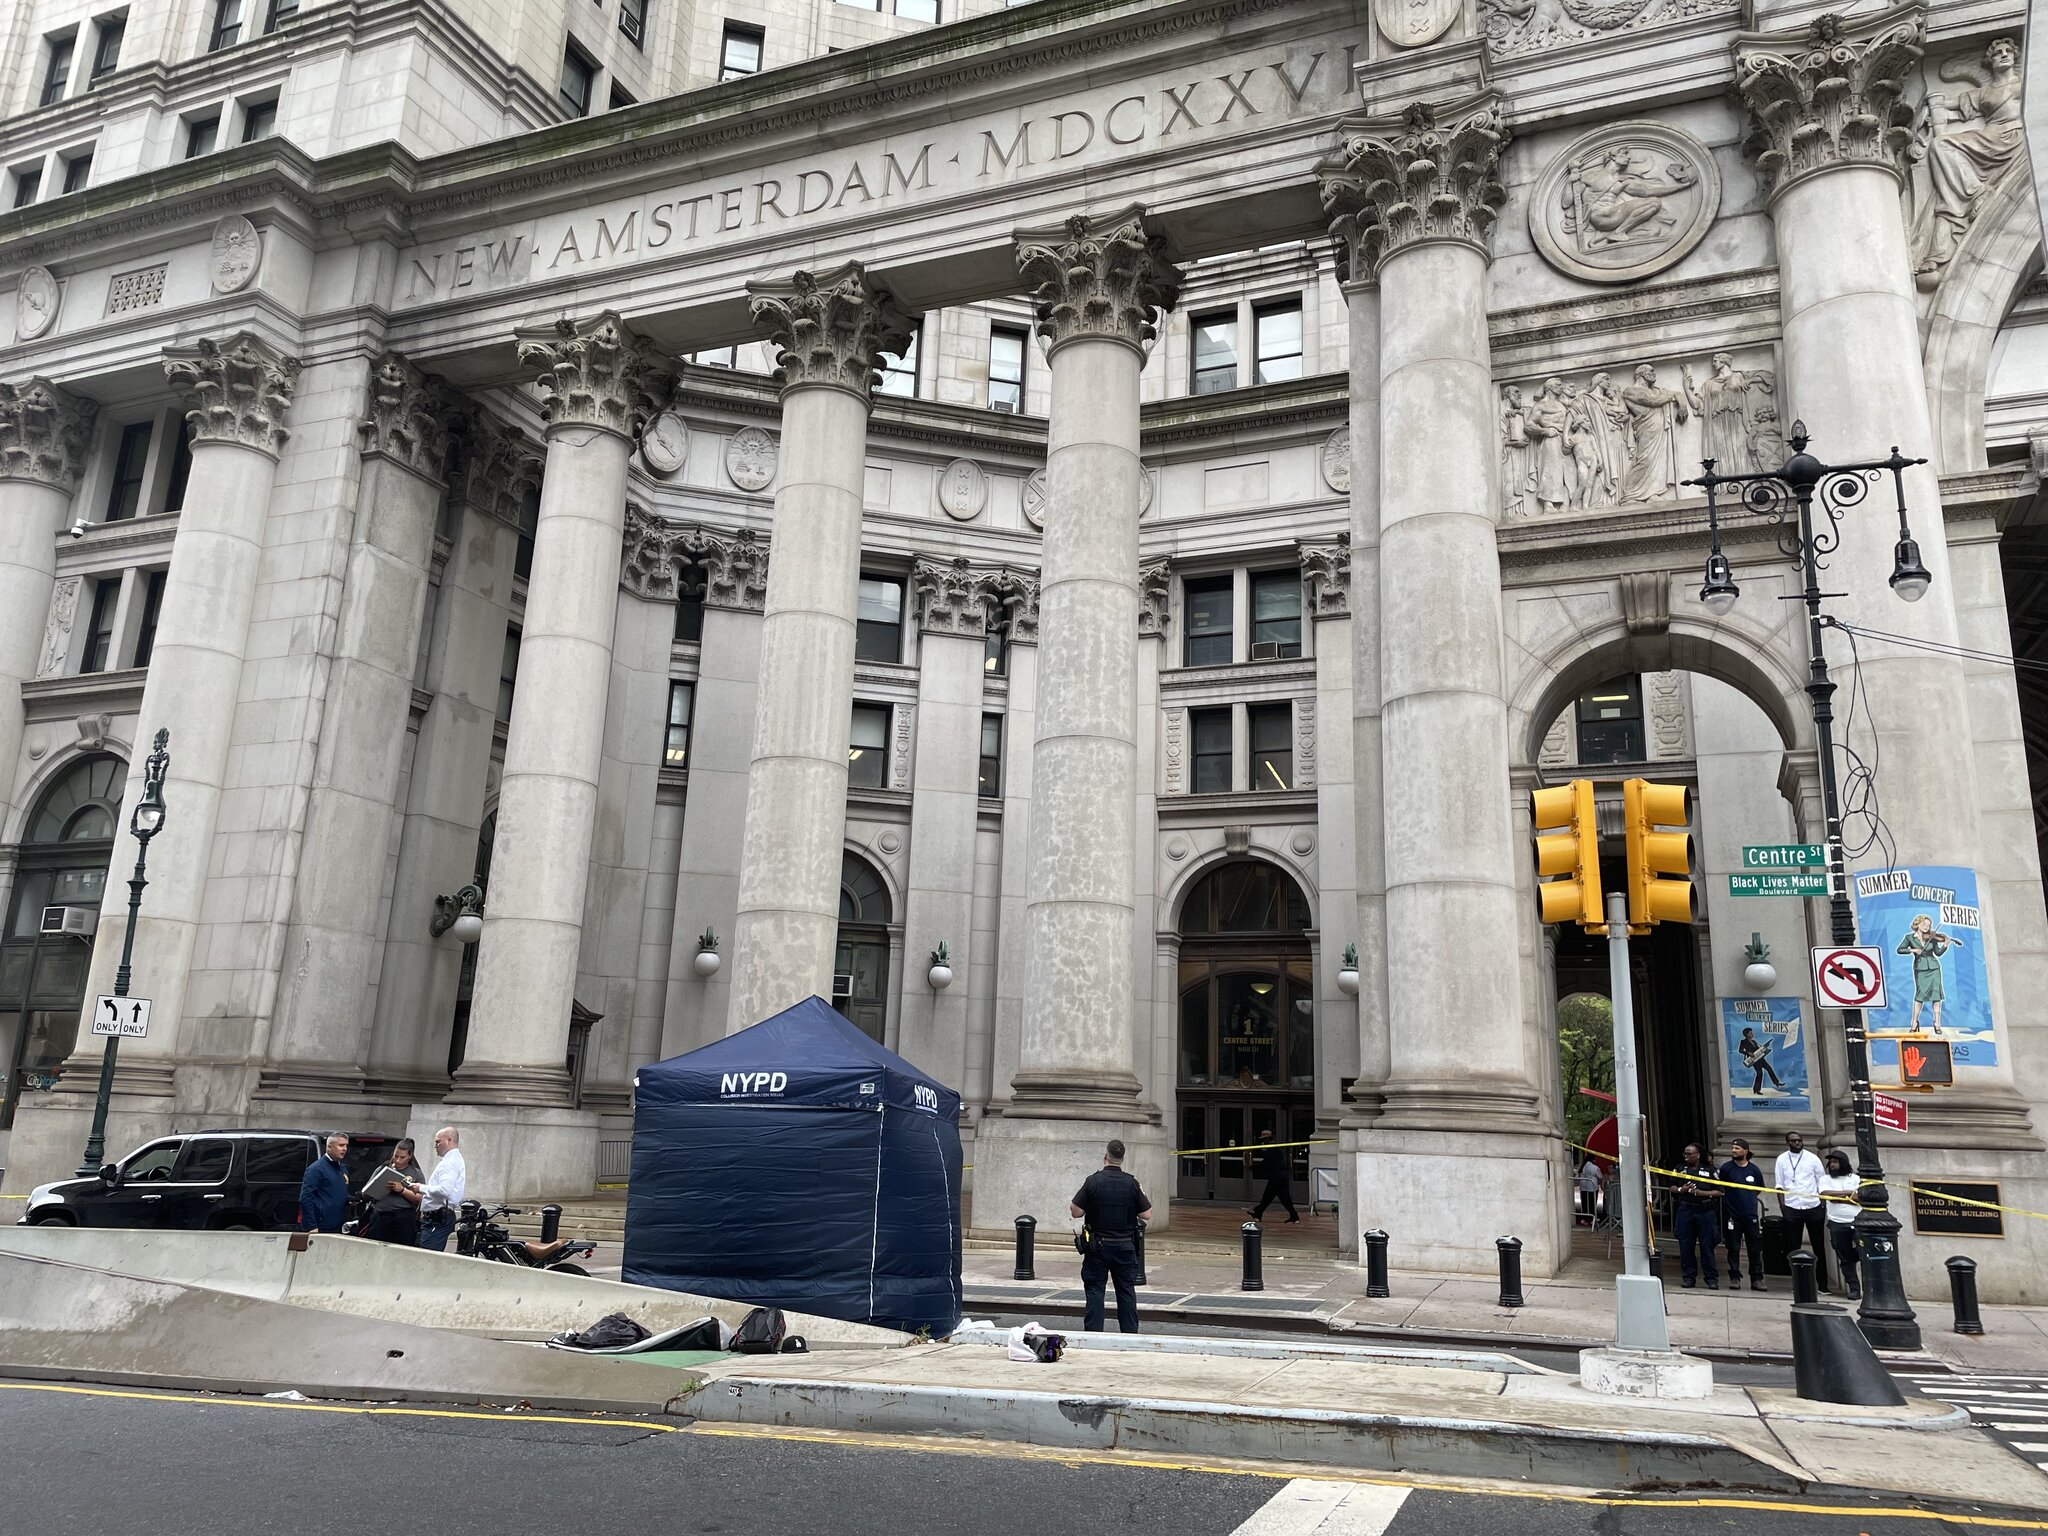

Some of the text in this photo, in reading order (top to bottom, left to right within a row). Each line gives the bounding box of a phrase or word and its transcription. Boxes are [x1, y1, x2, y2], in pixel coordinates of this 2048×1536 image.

[406, 44, 1361, 300] NEW AMSTERDAM MDCXXVI
[1748, 846, 1821, 865] Centre St
[1732, 875, 1824, 888] Black Lives Matter
[1858, 872, 1910, 896] SUMMER
[1911, 884, 1955, 904] CONCERT
[1942, 905, 1979, 928] SERIES
[1735, 1001, 1768, 1013] SUMMER
[1747, 1012, 1772, 1022] CONCERT
[96, 1022, 118, 1032] ONLY
[123, 1024, 145, 1034] ONLY
[1243, 1018, 1254, 1036] 1
[1764, 1022, 1789, 1033] SERIES
[1223, 1037, 1274, 1045] CENTRE STREET
[720, 1072, 788, 1093] NYPD
[914, 1084, 938, 1109] NYPD
[1883, 1097, 1903, 1109] STOPPING
[1917, 1198, 1945, 1206] DAVID
[1917, 1209, 1999, 1218] MUNICIPAL BUILDING
